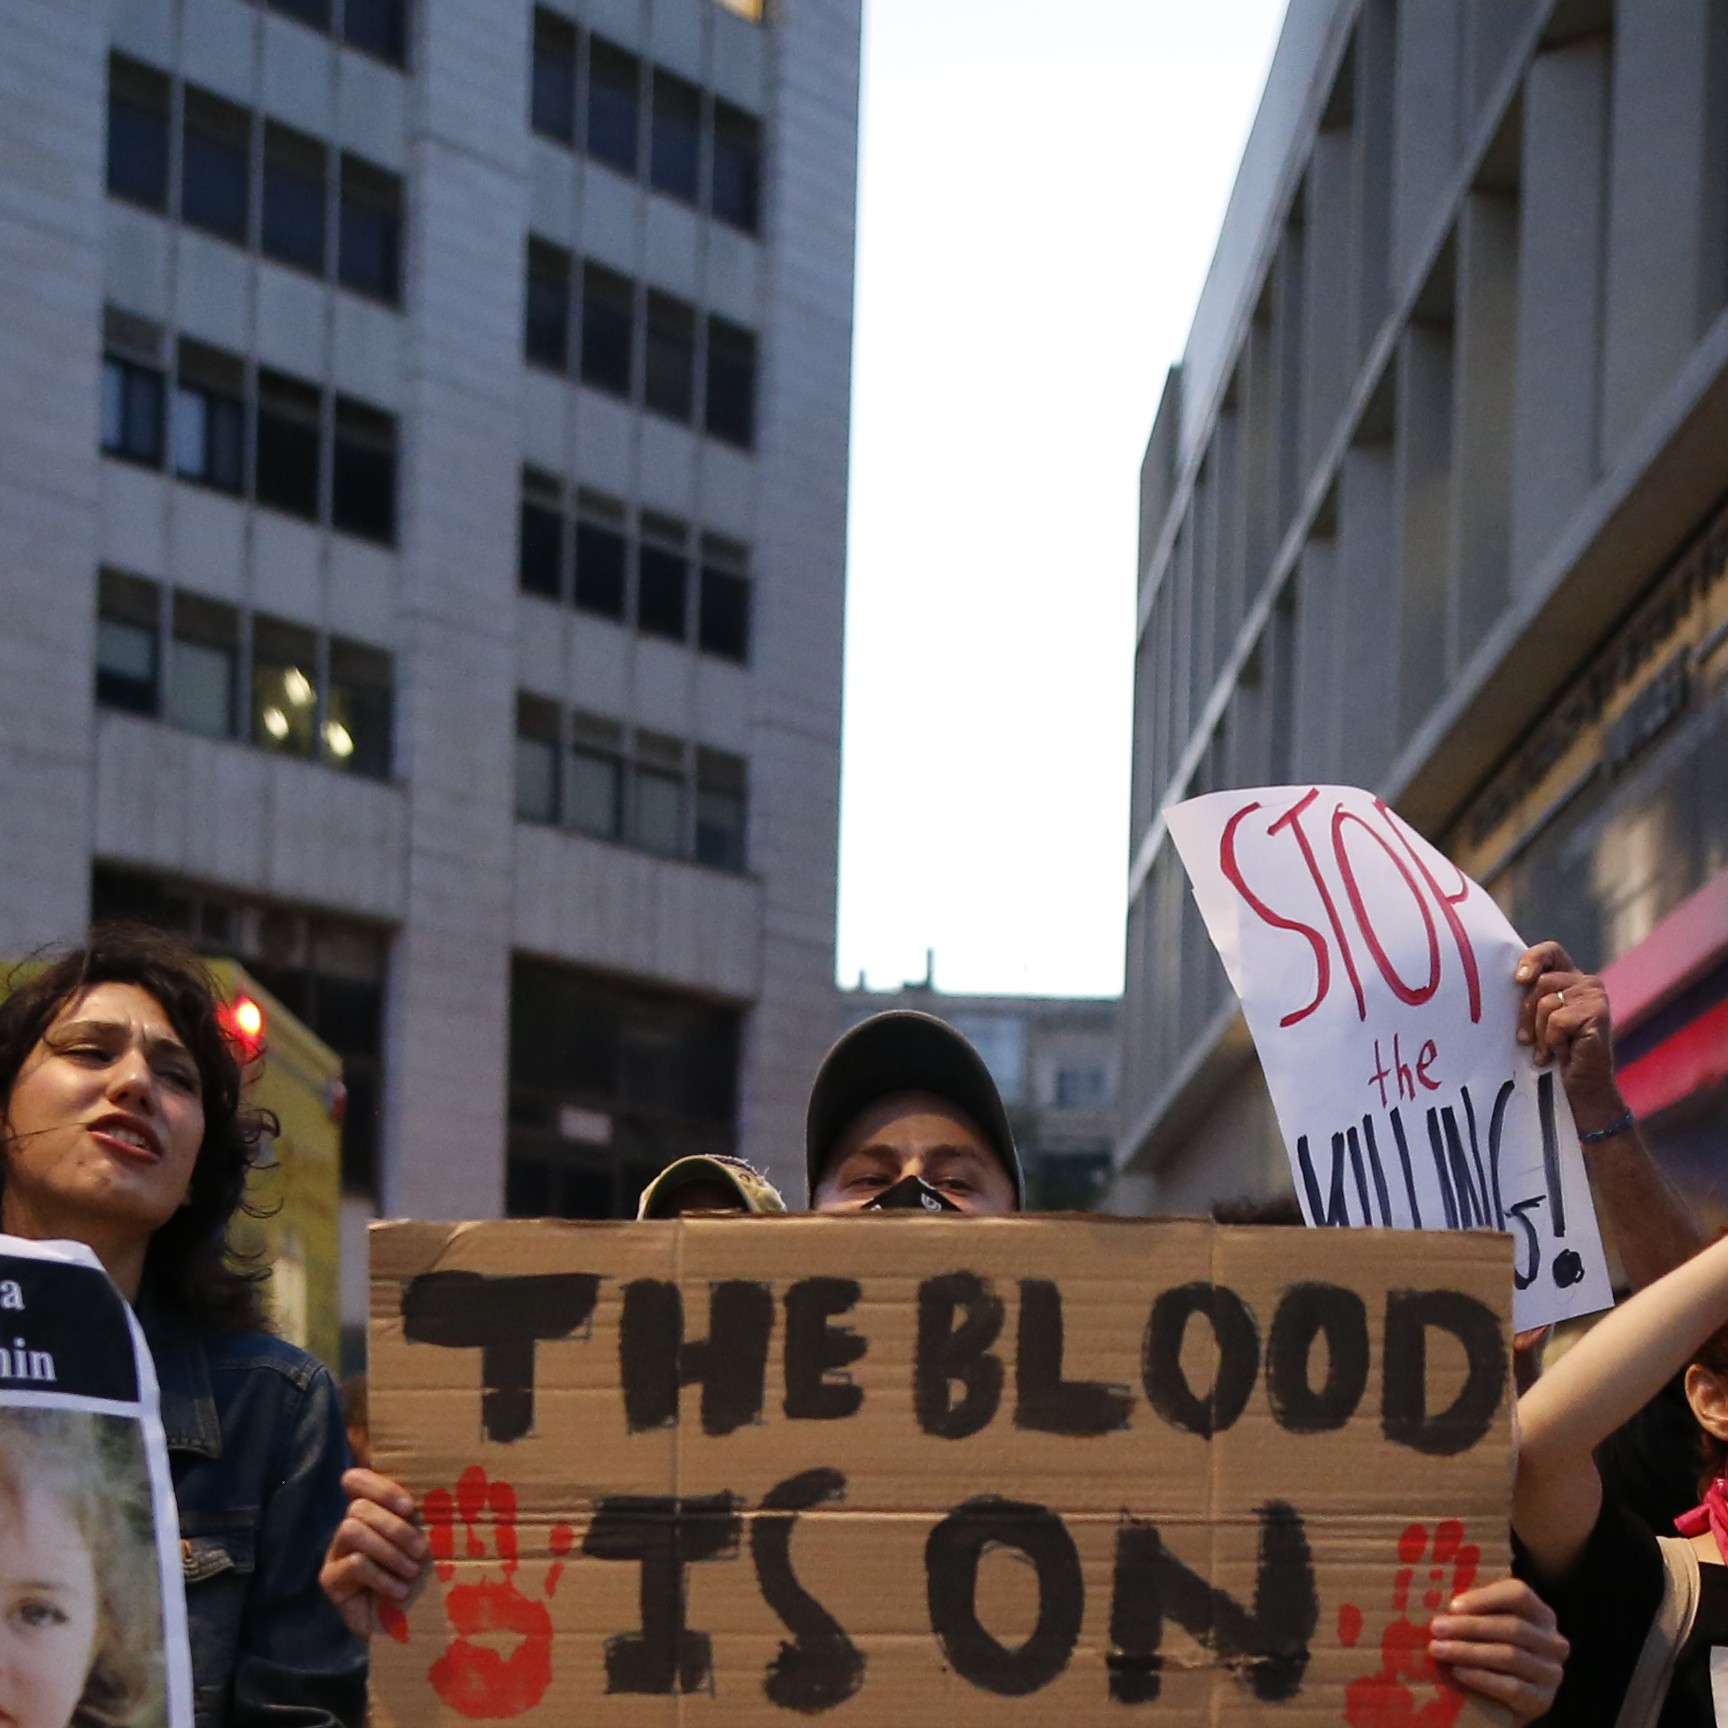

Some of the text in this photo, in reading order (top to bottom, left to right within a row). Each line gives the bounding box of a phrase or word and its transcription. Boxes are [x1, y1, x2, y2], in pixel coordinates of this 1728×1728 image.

[1219, 788, 1481, 1027] STOP
[1368, 1033, 1442, 1108] the
[400, 1269, 1510, 1456] THE BLOOD
[581, 1467, 1320, 1715] IS ON
